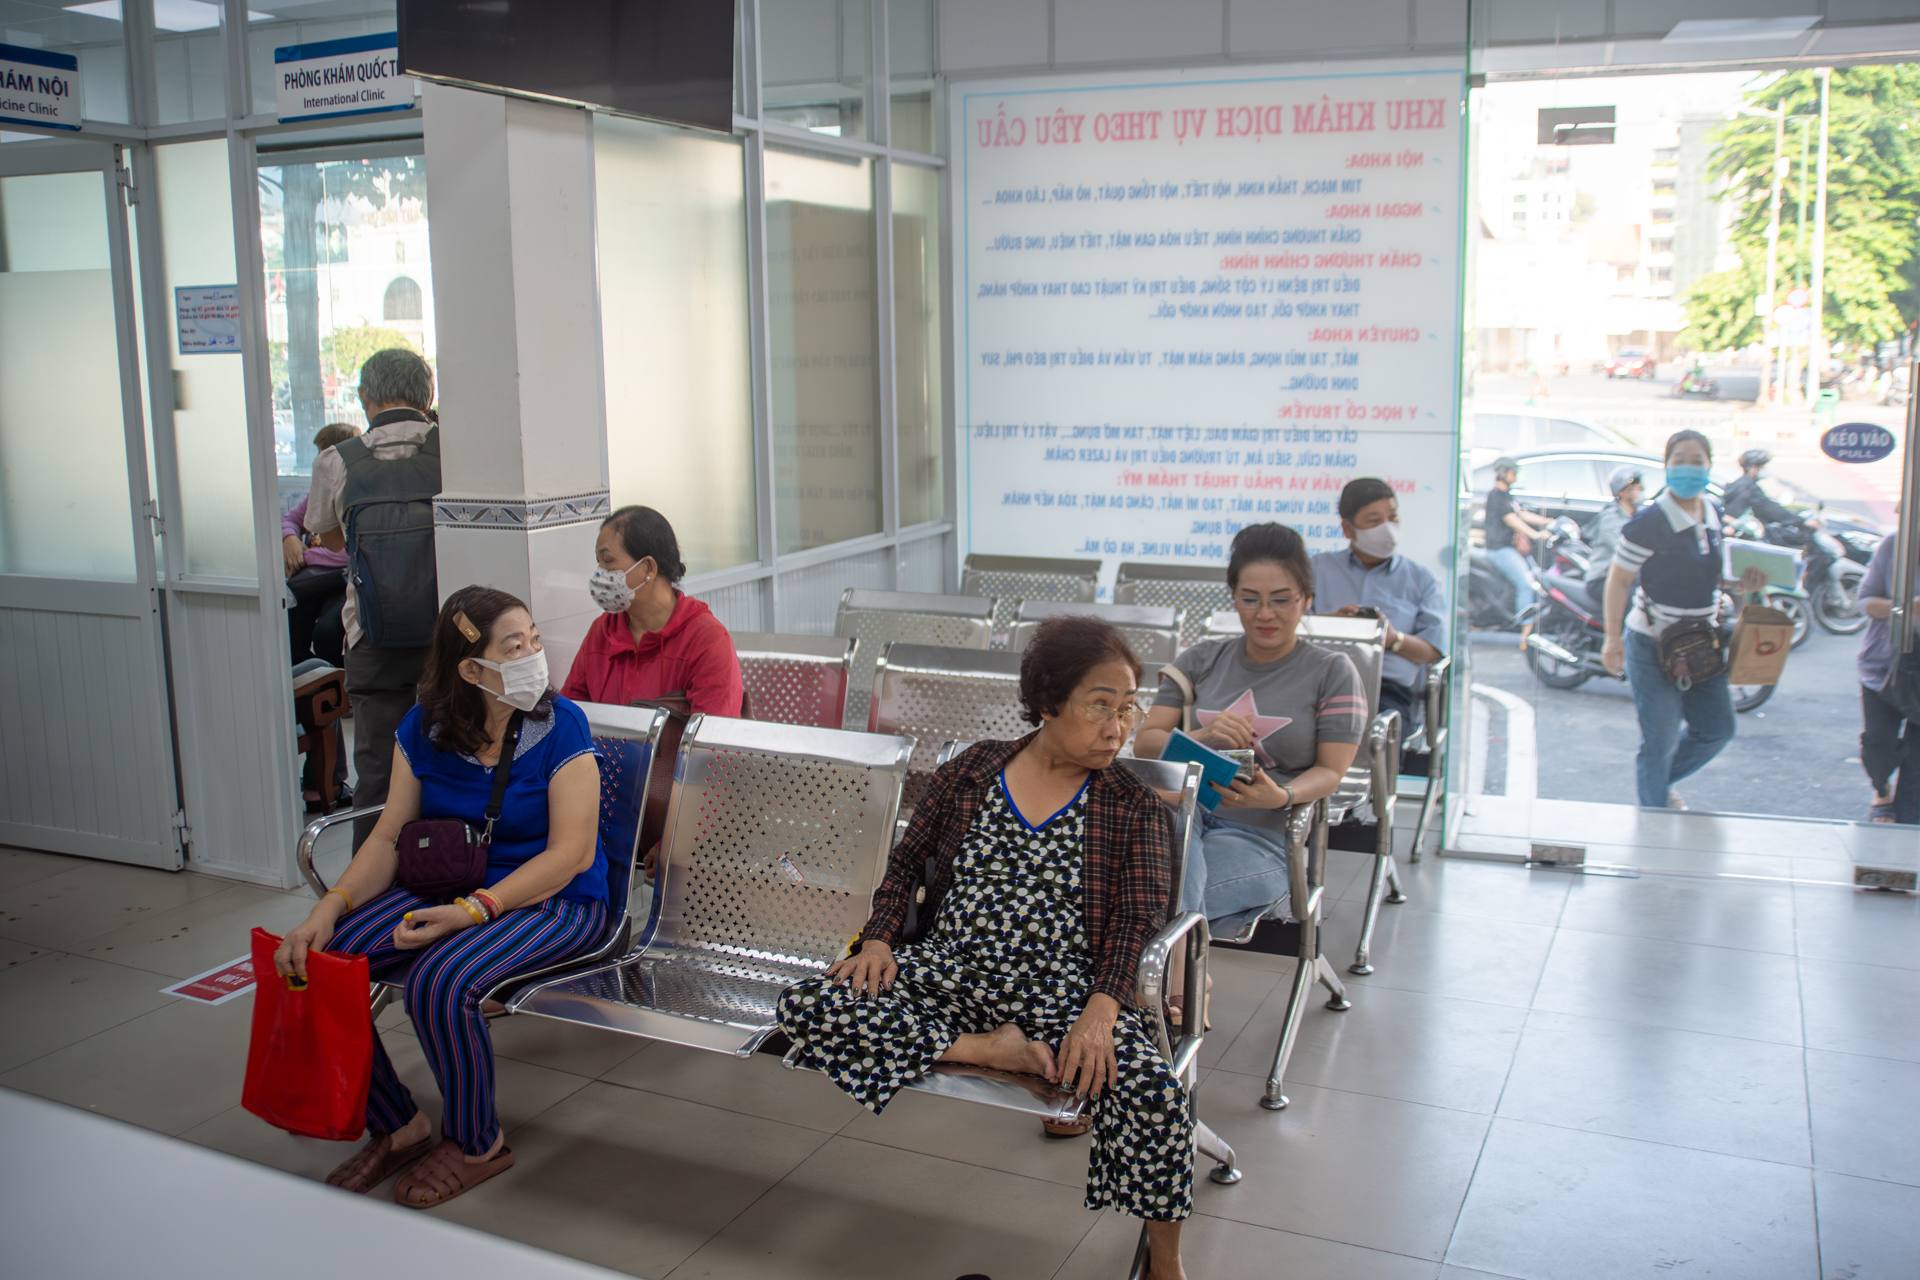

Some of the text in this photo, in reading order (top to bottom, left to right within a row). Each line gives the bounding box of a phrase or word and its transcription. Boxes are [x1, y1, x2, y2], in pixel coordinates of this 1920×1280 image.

[284, 68, 321, 90] PHÒNG
[323, 62, 355, 85] KHÁM
[357, 56, 388, 82] QUỐC
[38, 76, 69, 101] NỘI
[303, 88, 385, 108] International Clinic
[28, 101, 59, 116] Clinic
[1828, 428, 1891, 447] KÉO VÀO
[1838, 449, 1875, 459] PULL
